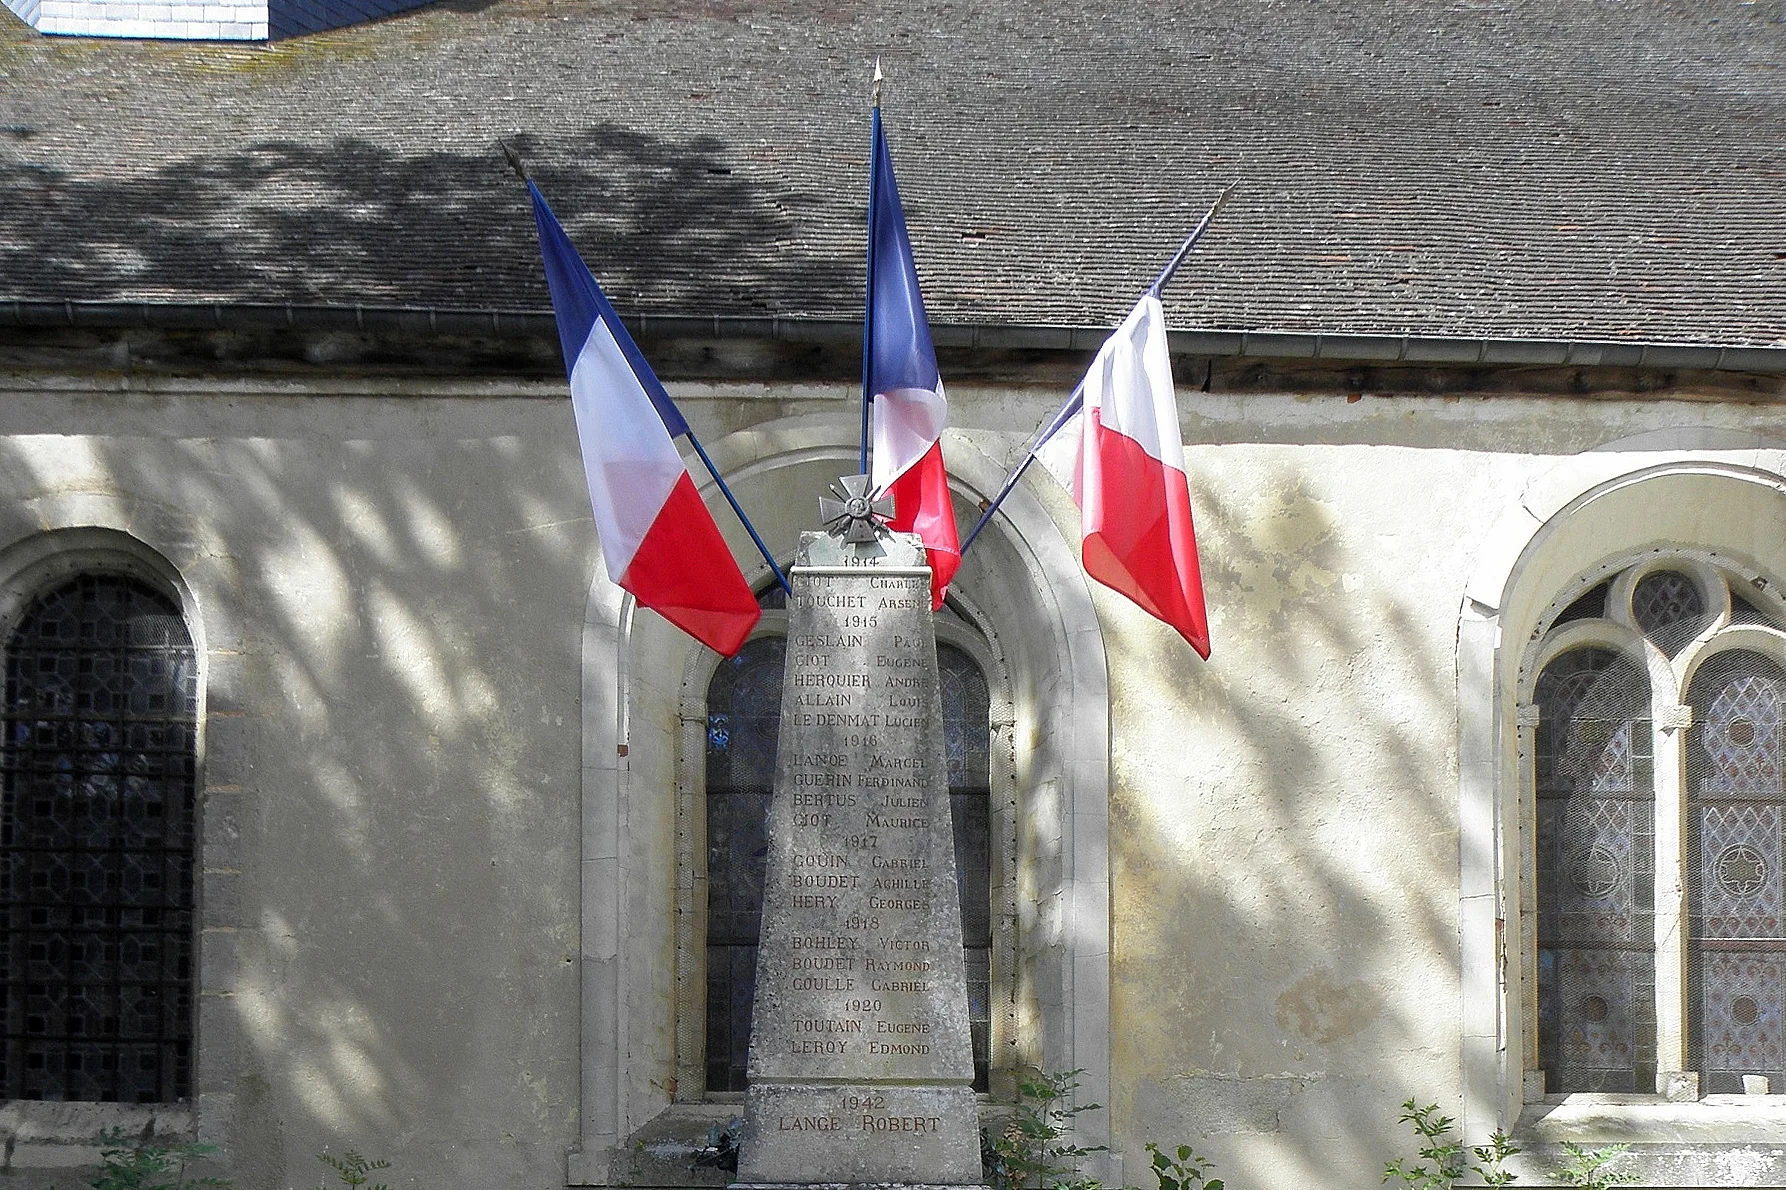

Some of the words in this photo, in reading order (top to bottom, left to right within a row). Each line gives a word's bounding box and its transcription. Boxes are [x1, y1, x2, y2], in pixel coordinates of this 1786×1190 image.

[870, 576, 926, 589] CHARLE
[796, 594, 867, 608] TOUCHET
[844, 615, 878, 628] 1915
[795, 634, 863, 648] GESLAIN
[893, 635, 928, 648] PAUL
[795, 655, 830, 667] GIOT
[876, 655, 928, 668] EUGENE
[794, 674, 871, 688] HERQUIER
[885, 676, 929, 688] ANDRE
[795, 694, 851, 706] ALLAIN
[889, 695, 929, 707] LOUIS
[793, 714, 812, 727] LE
[816, 714, 880, 727] DENMAT
[885, 715, 930, 727] LUCIEN
[843, 735, 878, 748] 1916
[793, 754, 848, 767] LANOE
[870, 754, 928, 769] MARCEL
[793, 773, 852, 787] GUERIN
[857, 774, 929, 788] FERDINAND
[793, 793, 857, 807] BERTUS
[881, 795, 929, 808] JULIEN
[793, 814, 832, 827] GIOT
[865, 813, 930, 828] MAURICE
[842, 835, 878, 848] 1917
[793, 854, 848, 868] GOUIN
[872, 855, 928, 869] GABRIEL
[792, 875, 860, 888] BOUDET
[872, 877, 930, 889] ACHILLE
[792, 895, 838, 909] HERY
[869, 897, 930, 910] GEORGES
[844, 917, 880, 930] 1918
[792, 937, 859, 950] BOHLEY
[879, 937, 930, 951] VICTOR
[792, 957, 856, 971] BOUDET
[865, 958, 930, 972] RAYMOND
[792, 978, 855, 991] GOULLE
[872, 979, 930, 992] GABRIEL
[844, 999, 882, 1012] 1920
[793, 1020, 862, 1033] TOUTAIN
[877, 1021, 930, 1034] EUGENE
[792, 1041, 848, 1054] LEROY
[869, 1041, 930, 1055] EDMOND
[841, 1096, 885, 1110] 1942
[779, 1116, 841, 1131] LANGE
[862, 1115, 941, 1132] ROBERT
